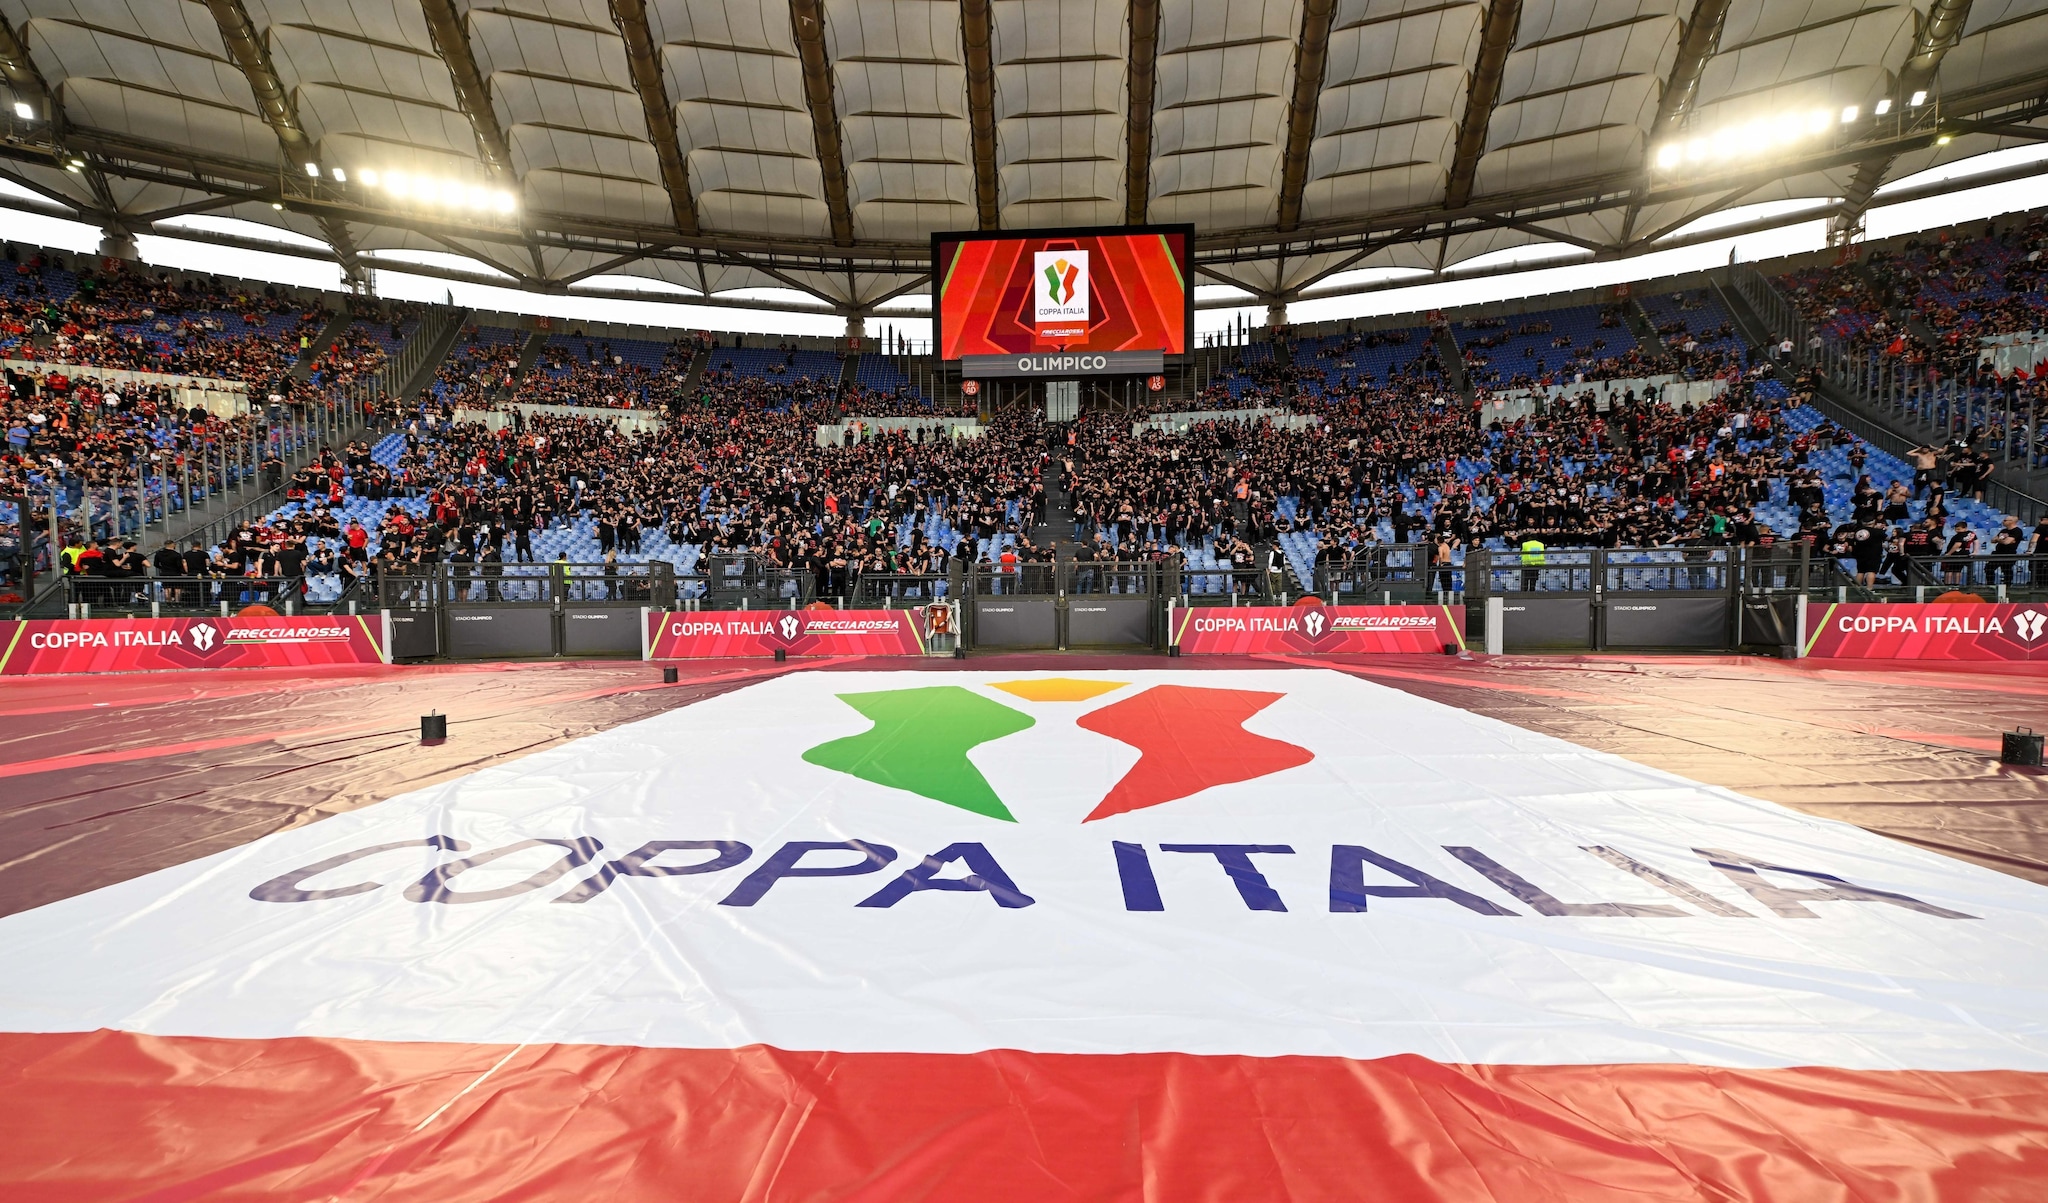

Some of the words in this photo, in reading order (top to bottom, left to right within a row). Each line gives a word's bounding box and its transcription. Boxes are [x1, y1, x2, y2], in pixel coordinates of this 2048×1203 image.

[1039, 308, 1062, 316] COPPA
[1018, 355, 1107, 372] OLIMPICO
[965, 386, 977, 394] AD
[1152, 382, 1162, 390] AS
[806, 620, 900, 630] FRECCIAROSSA
[1195, 618, 1247, 632] COPPA
[1250, 617, 1299, 632] ITALIA
[1333, 616, 1437, 627] FRECCIAROSSA
[1838, 616, 1918, 634] COPPA
[1925, 616, 2004, 634] ITALIA
[226, 627, 351, 640] FRECCIAROSSA
[671, 622, 724, 637] COPPA
[727, 621, 775, 636] ITALIA
[31, 632, 109, 649] COPPA
[114, 630, 183, 647] ITALIA
[249, 835, 1036, 909] COPPA
[1112, 839, 1985, 920] ITALIA
